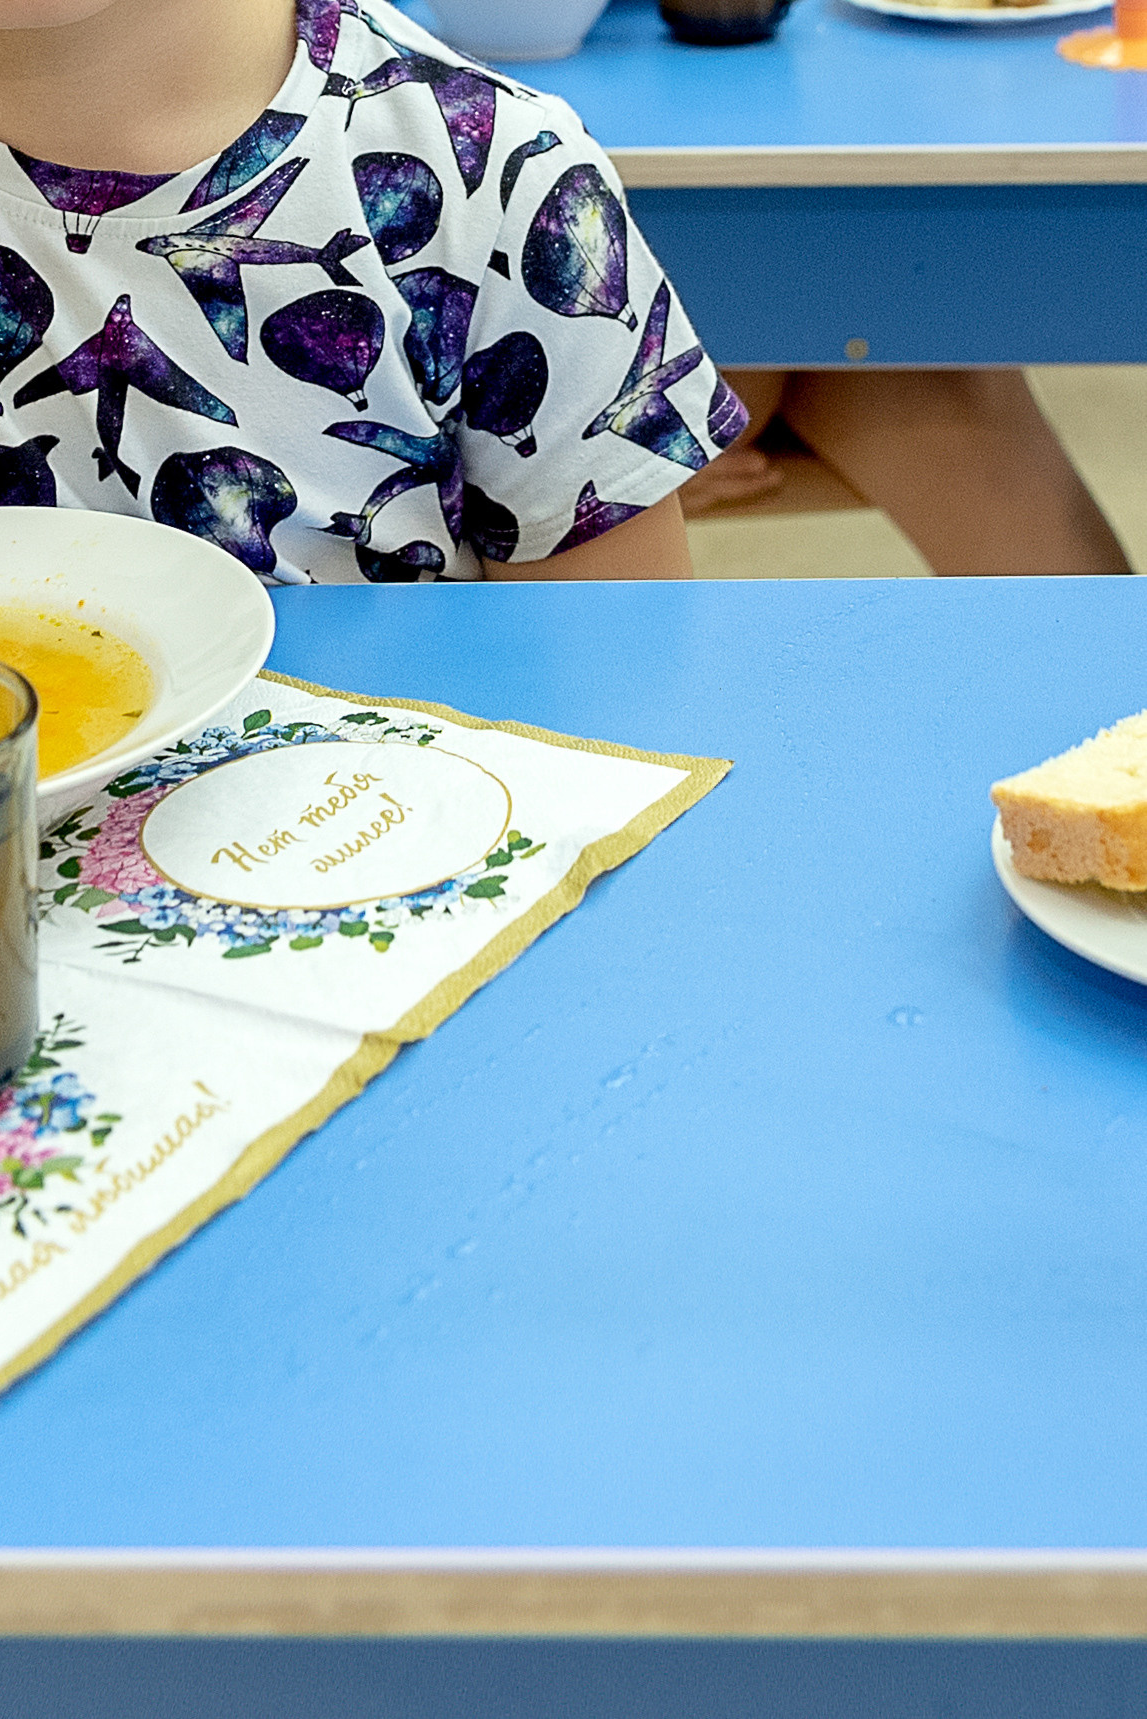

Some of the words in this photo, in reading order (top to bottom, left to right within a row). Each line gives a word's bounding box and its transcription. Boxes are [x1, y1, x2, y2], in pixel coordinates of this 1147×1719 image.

[210, 829, 307, 873] Нет
[297, 770, 384, 828] тебя
[309, 792, 414, 874] милее!
[69, 1079, 232, 1234] любимая!
